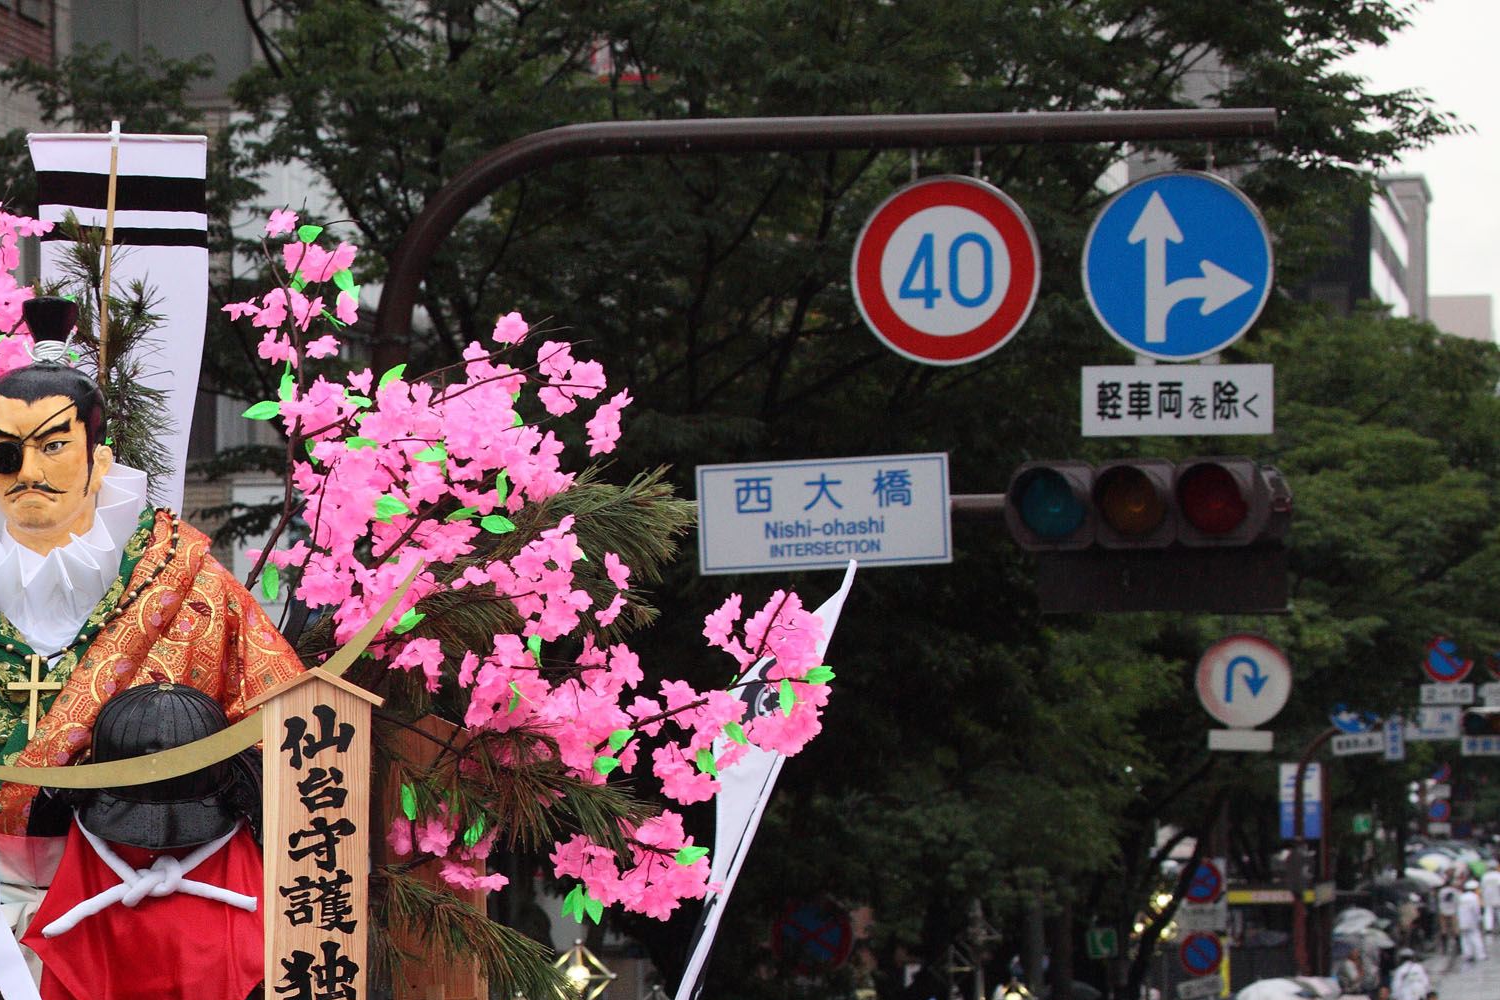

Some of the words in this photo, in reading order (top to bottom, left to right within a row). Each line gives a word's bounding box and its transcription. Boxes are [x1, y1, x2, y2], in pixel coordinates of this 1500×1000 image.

[900, 231, 992, 310] 40
[1097, 381, 1260, 420] 軽車両を除く
[734, 468, 913, 514] 西大橋
[765, 515, 885, 539] Nishi-ohashi
[770, 538, 881, 558] INTERSECTION
